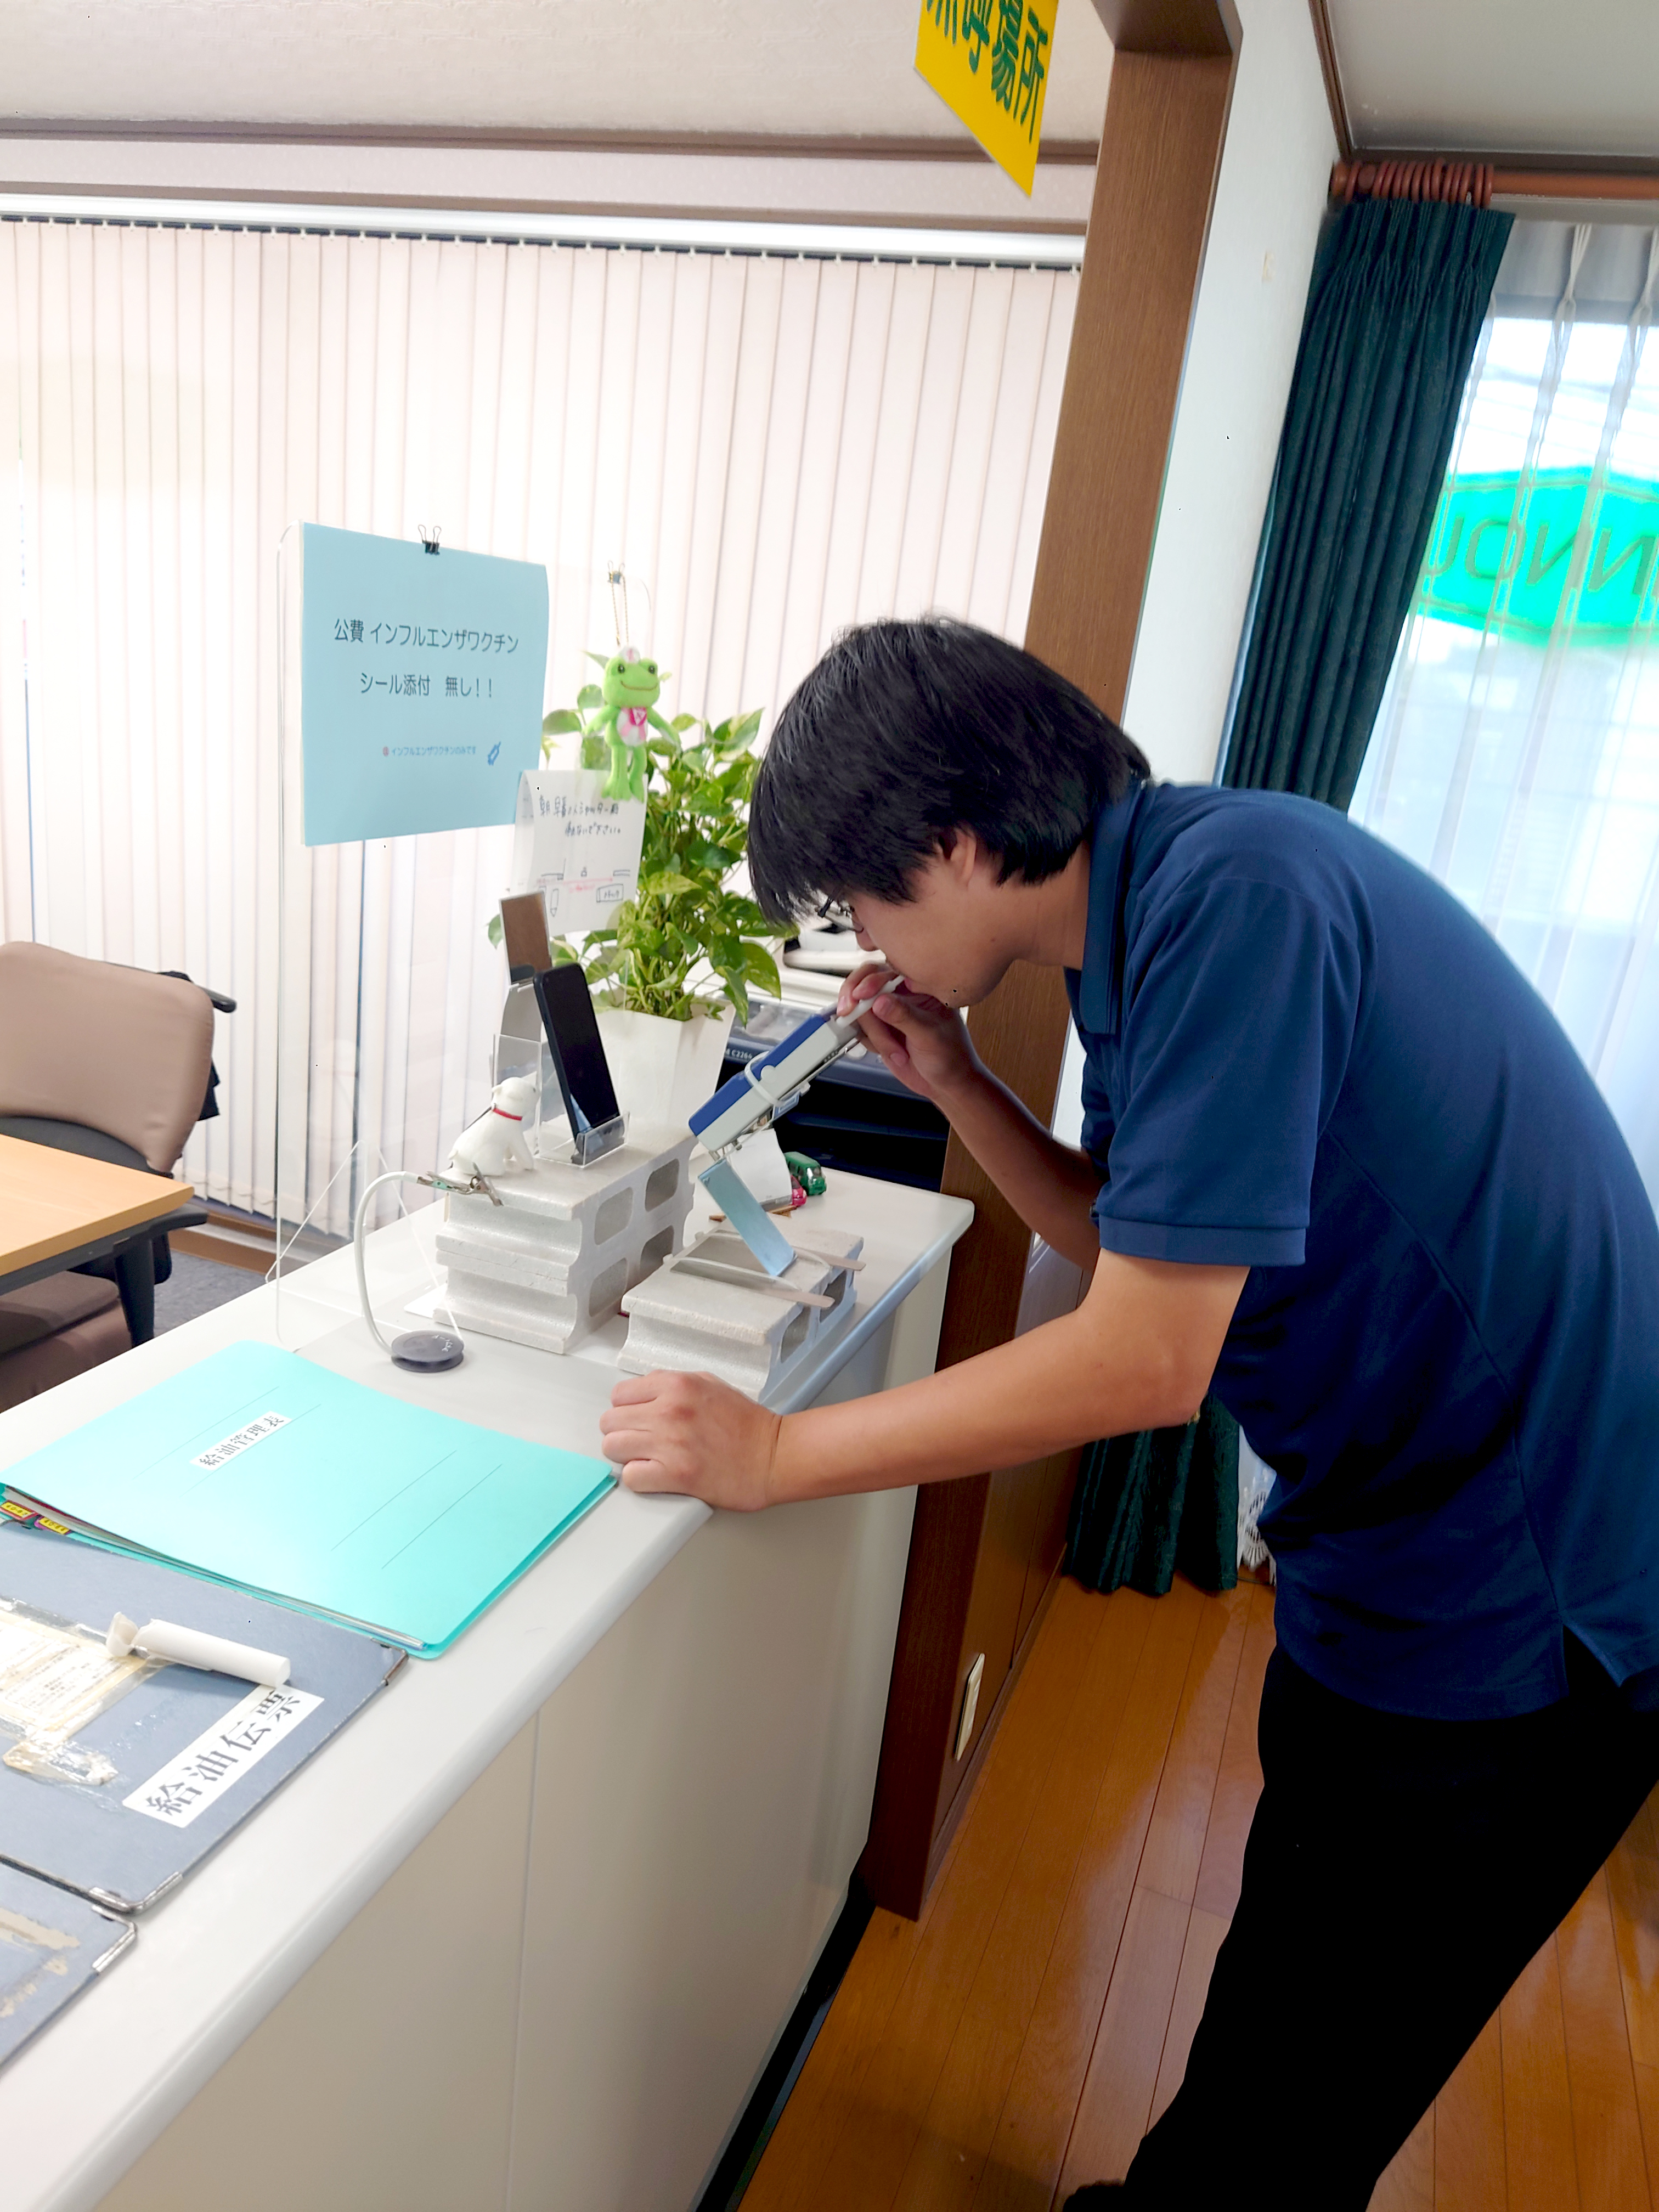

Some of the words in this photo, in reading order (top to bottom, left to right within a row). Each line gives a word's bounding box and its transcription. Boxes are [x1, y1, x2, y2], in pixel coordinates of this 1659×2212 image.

[334, 618, 364, 643] 公費
[370, 622, 519, 653] インフルエンザワクチン
[360, 672, 431, 696] シール添付
[392, 746, 476, 757] インフルエンザワクチンのみです
[199, 1415, 285, 1466] 給油管理表
[145, 1690, 301, 1816] 給油伝票
